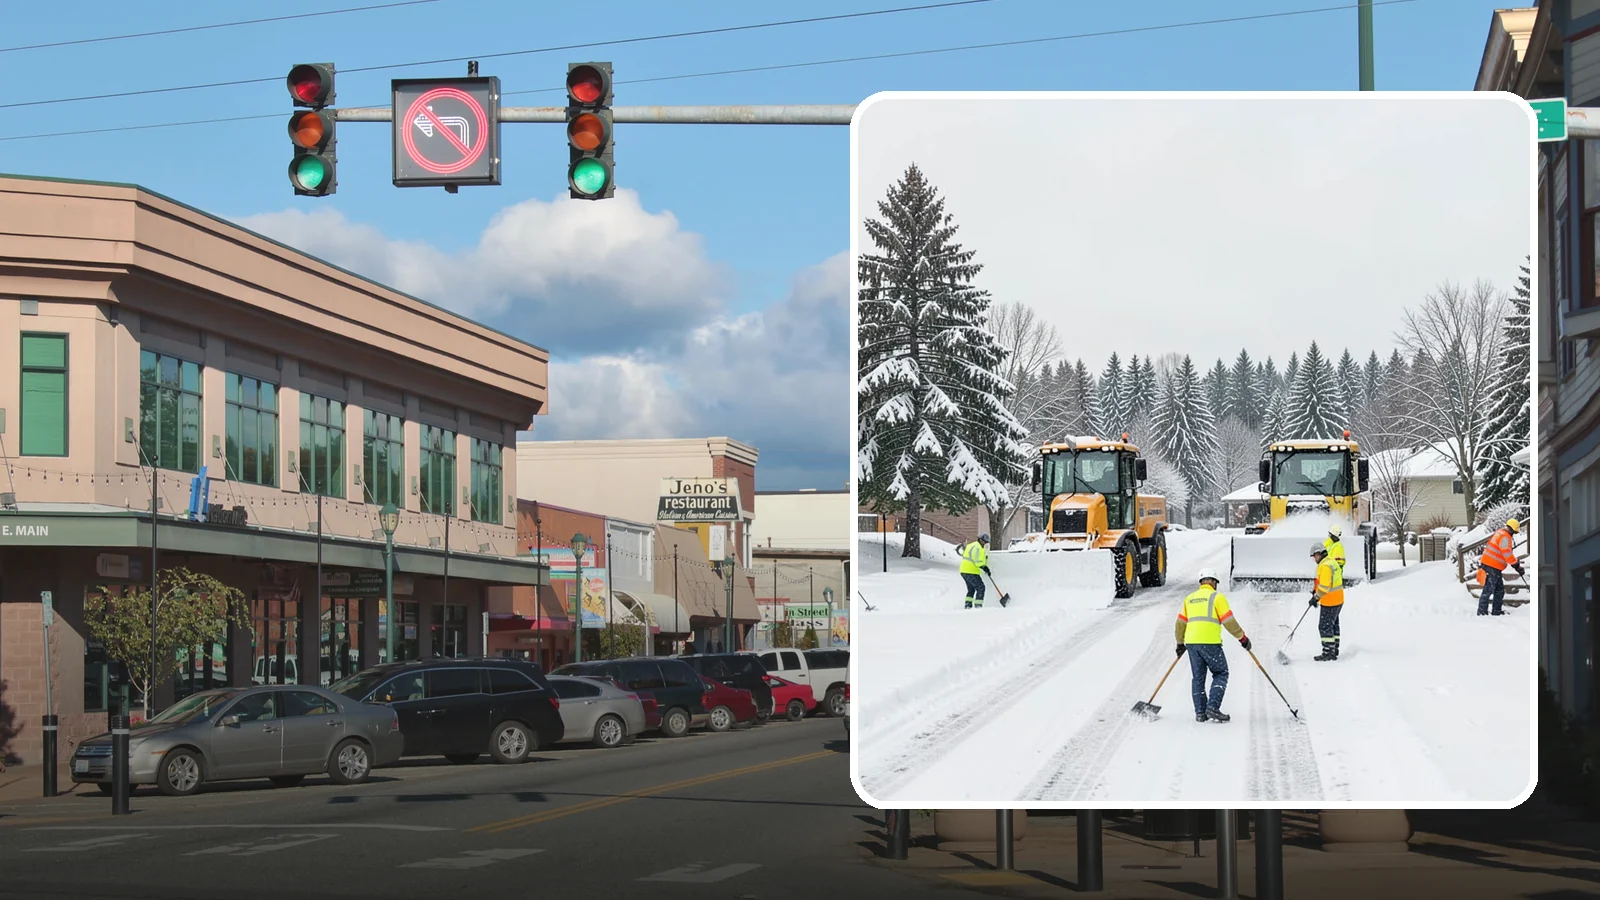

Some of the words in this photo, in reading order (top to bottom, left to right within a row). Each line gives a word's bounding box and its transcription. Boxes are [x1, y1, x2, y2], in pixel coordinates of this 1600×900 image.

[669, 480, 727, 494] Jeno's
[665, 496, 731, 509] restaurant
[686, 509, 714, 519] American
[715, 509, 737, 519] Cuisine
[2, 525, 13, 536] E.
[15, 525, 49, 536] MAIN
[797, 607, 828, 617] Street
